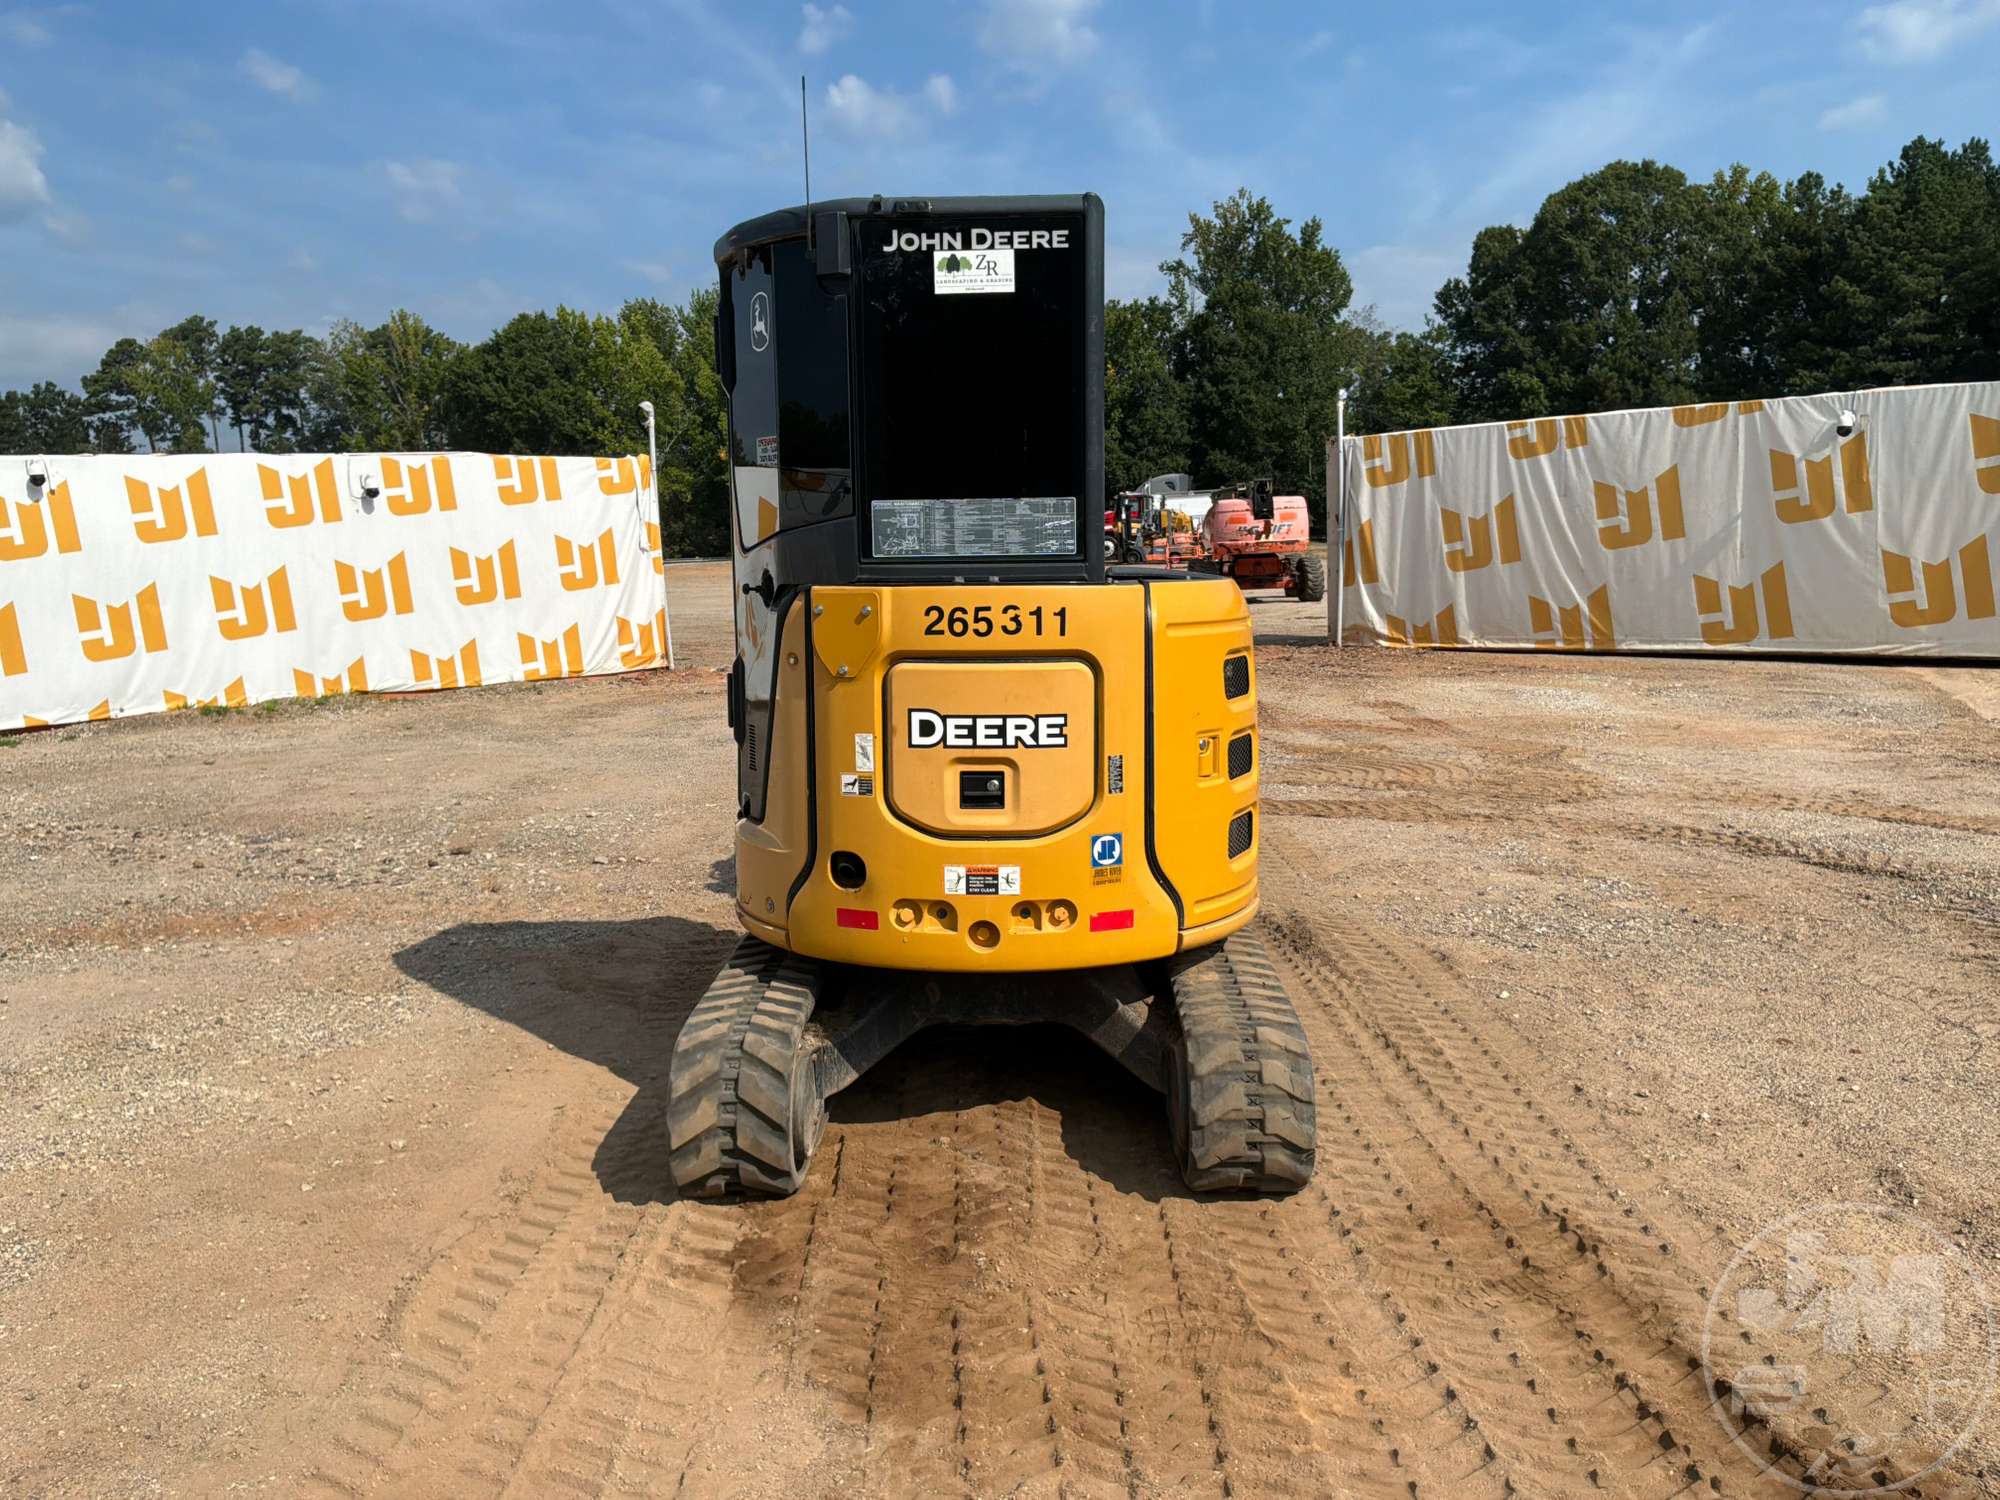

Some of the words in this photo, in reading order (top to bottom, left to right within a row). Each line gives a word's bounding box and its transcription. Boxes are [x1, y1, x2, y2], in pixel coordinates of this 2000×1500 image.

[882, 229, 963, 252] JOHN
[970, 228, 1069, 250] DEERE
[923, 605, 1068, 637] 265311
[909, 709, 1067, 748] DEERE
